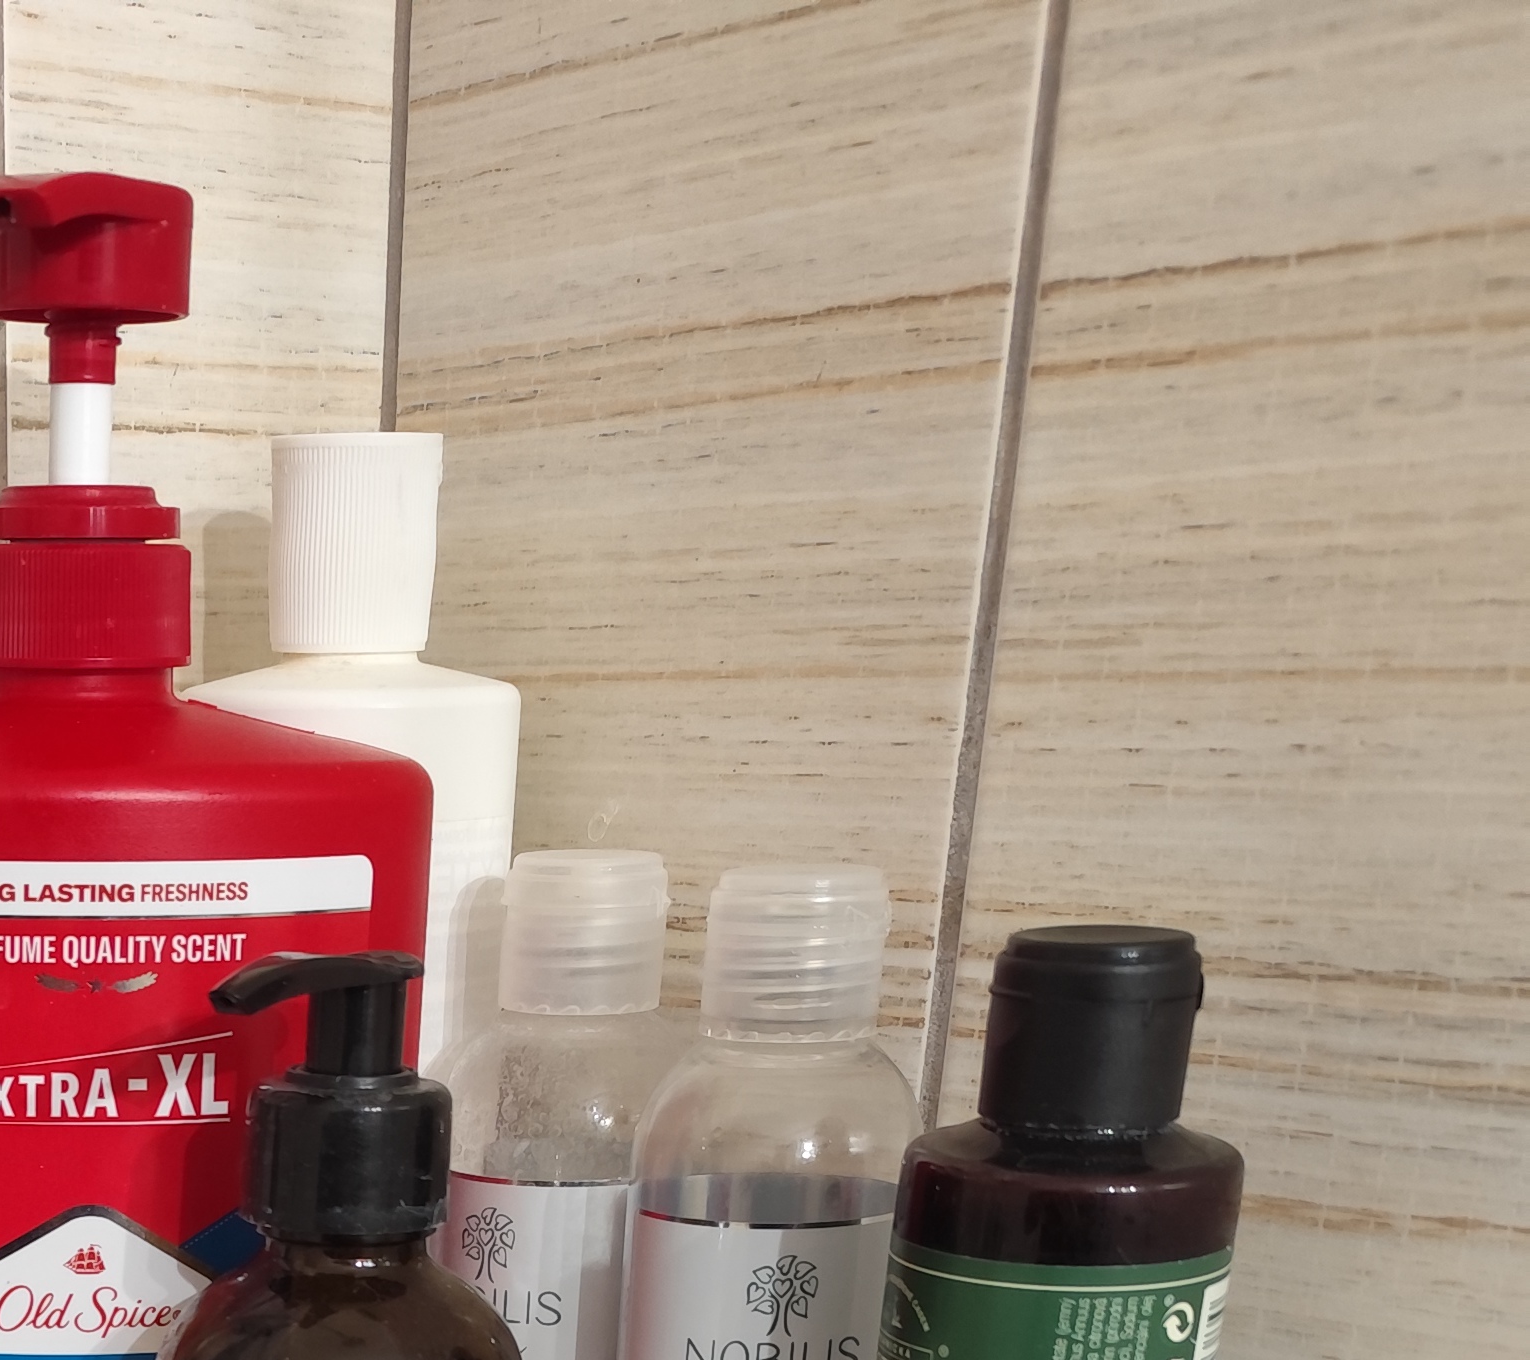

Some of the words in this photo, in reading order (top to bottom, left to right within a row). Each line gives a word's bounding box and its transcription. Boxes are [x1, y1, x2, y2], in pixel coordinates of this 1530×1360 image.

[23, 884, 136, 903] LASTING
[140, 881, 249, 902] FRESHNESS
[62, 934, 167, 968] QUALITY
[171, 933, 247, 964] SCENT
[74, 1286, 172, 1339] Spice
